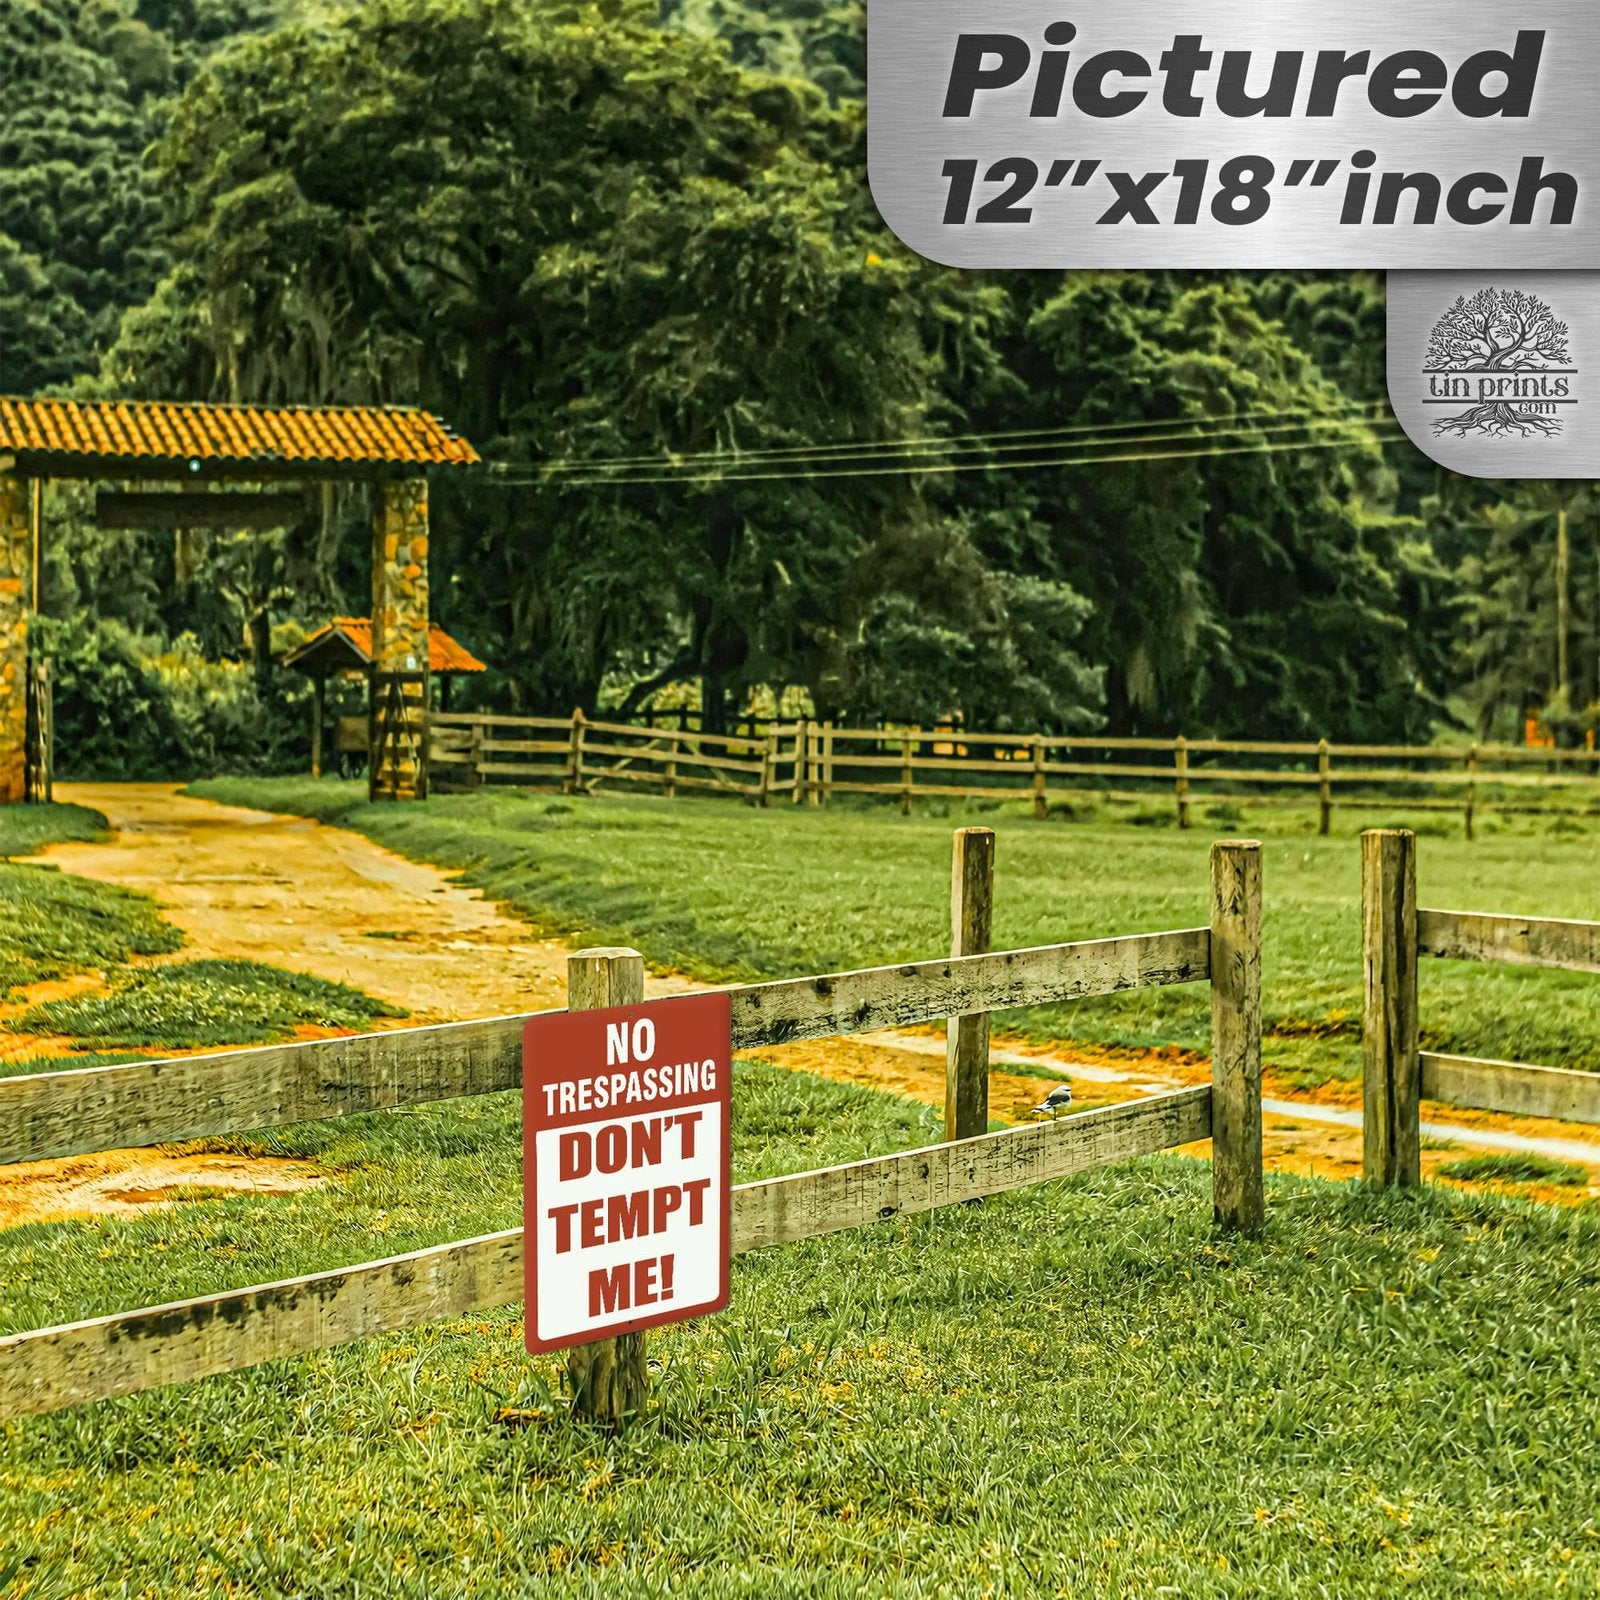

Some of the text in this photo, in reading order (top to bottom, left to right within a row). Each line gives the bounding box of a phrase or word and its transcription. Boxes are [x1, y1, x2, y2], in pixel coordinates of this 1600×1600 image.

[606, 1018, 655, 1066] NO
[542, 1059, 716, 1116] TRESPASSING
[559, 1111, 703, 1182] DON'T
[547, 1178, 711, 1254] TEMPT
[588, 1253, 675, 1317] ME!
